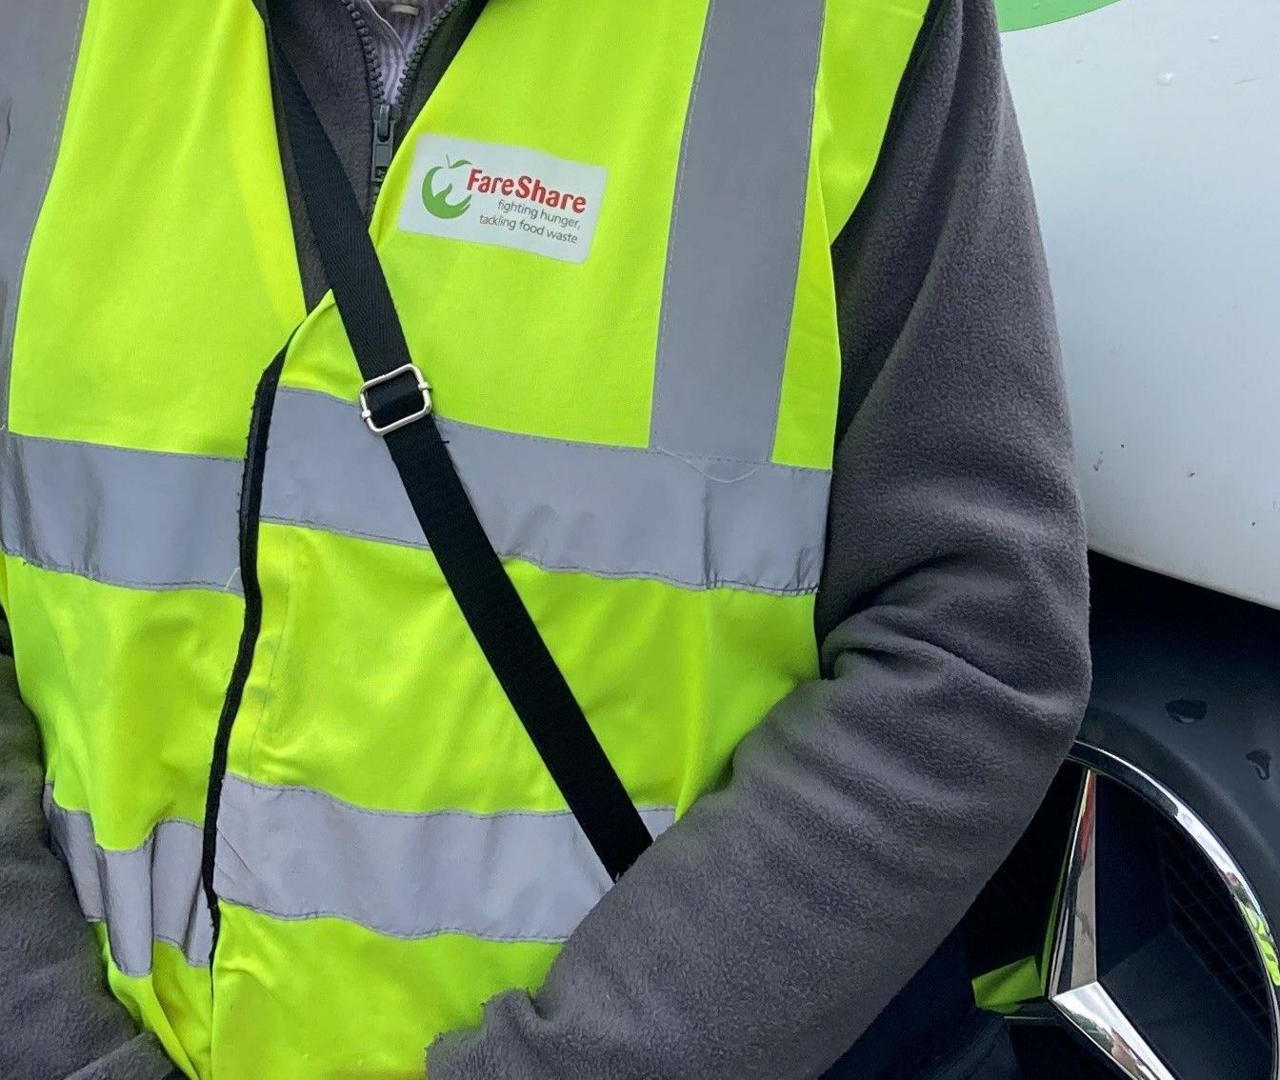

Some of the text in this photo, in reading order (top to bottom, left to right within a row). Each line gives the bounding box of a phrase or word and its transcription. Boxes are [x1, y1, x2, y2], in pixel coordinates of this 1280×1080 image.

[467, 169, 587, 213] FareShare
[480, 214, 578, 244] tackling food waste
[498, 199, 581, 230] fighting hunger,
